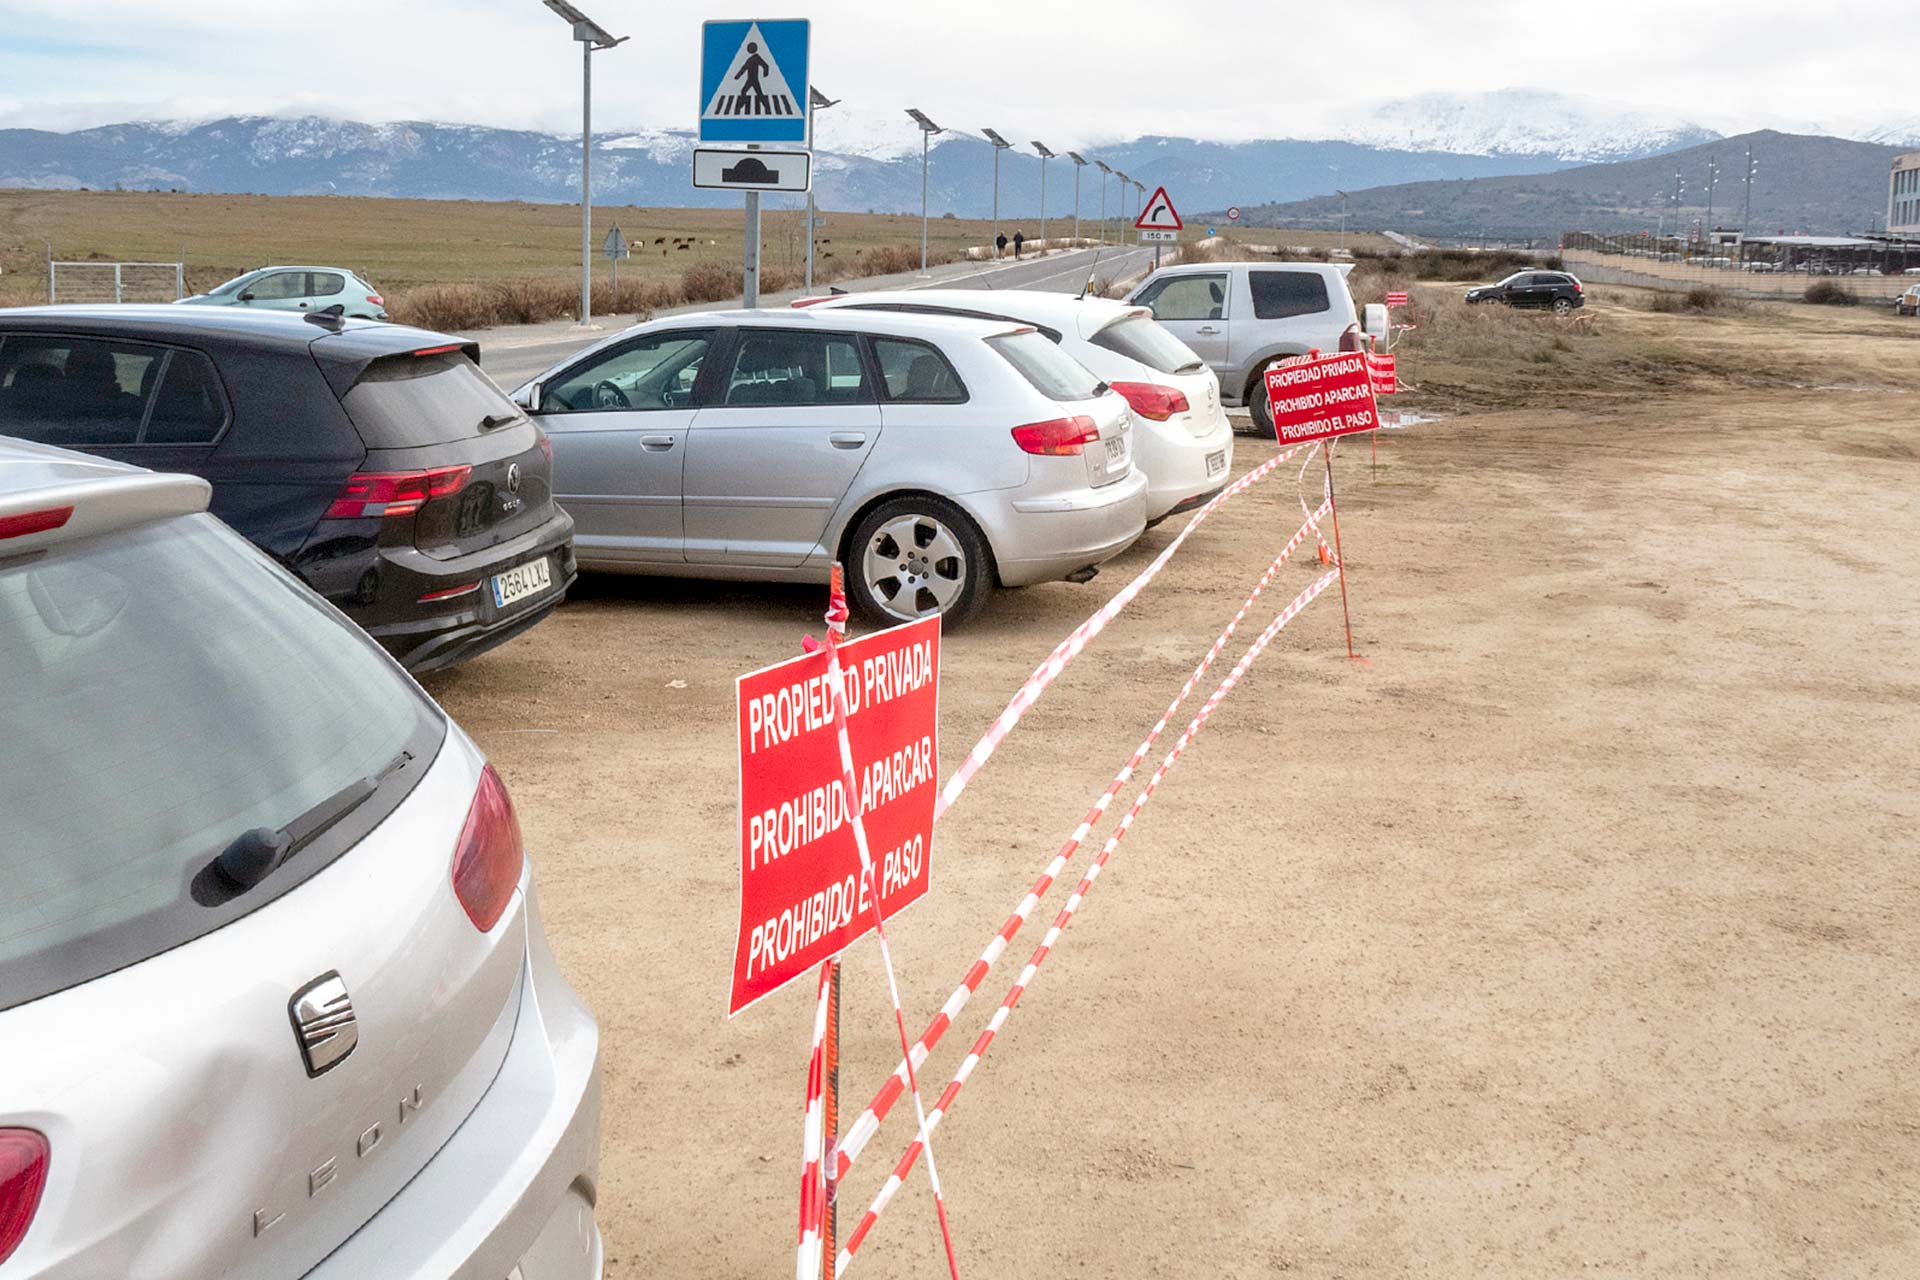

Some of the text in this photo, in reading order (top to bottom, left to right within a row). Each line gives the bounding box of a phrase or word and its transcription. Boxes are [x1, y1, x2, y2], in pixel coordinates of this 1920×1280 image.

[1146, 232, 1162, 240] 150
[1269, 366, 1321, 389] PROPIEDAD
[1322, 358, 1364, 379] PRIVADA
[1274, 383, 1370, 415] PROHIBIDO APARCAR
[1281, 411, 1372, 440] PROHIBIDO EL PASO
[500, 561, 549, 600] 2564 LXL
[863, 639, 933, 709] PRIVADA
[860, 735, 934, 816] APARCAR
[747, 873, 855, 980] PROHIBIDO
[882, 833, 923, 900] PASO
[253, 1083, 423, 1238] LEON
